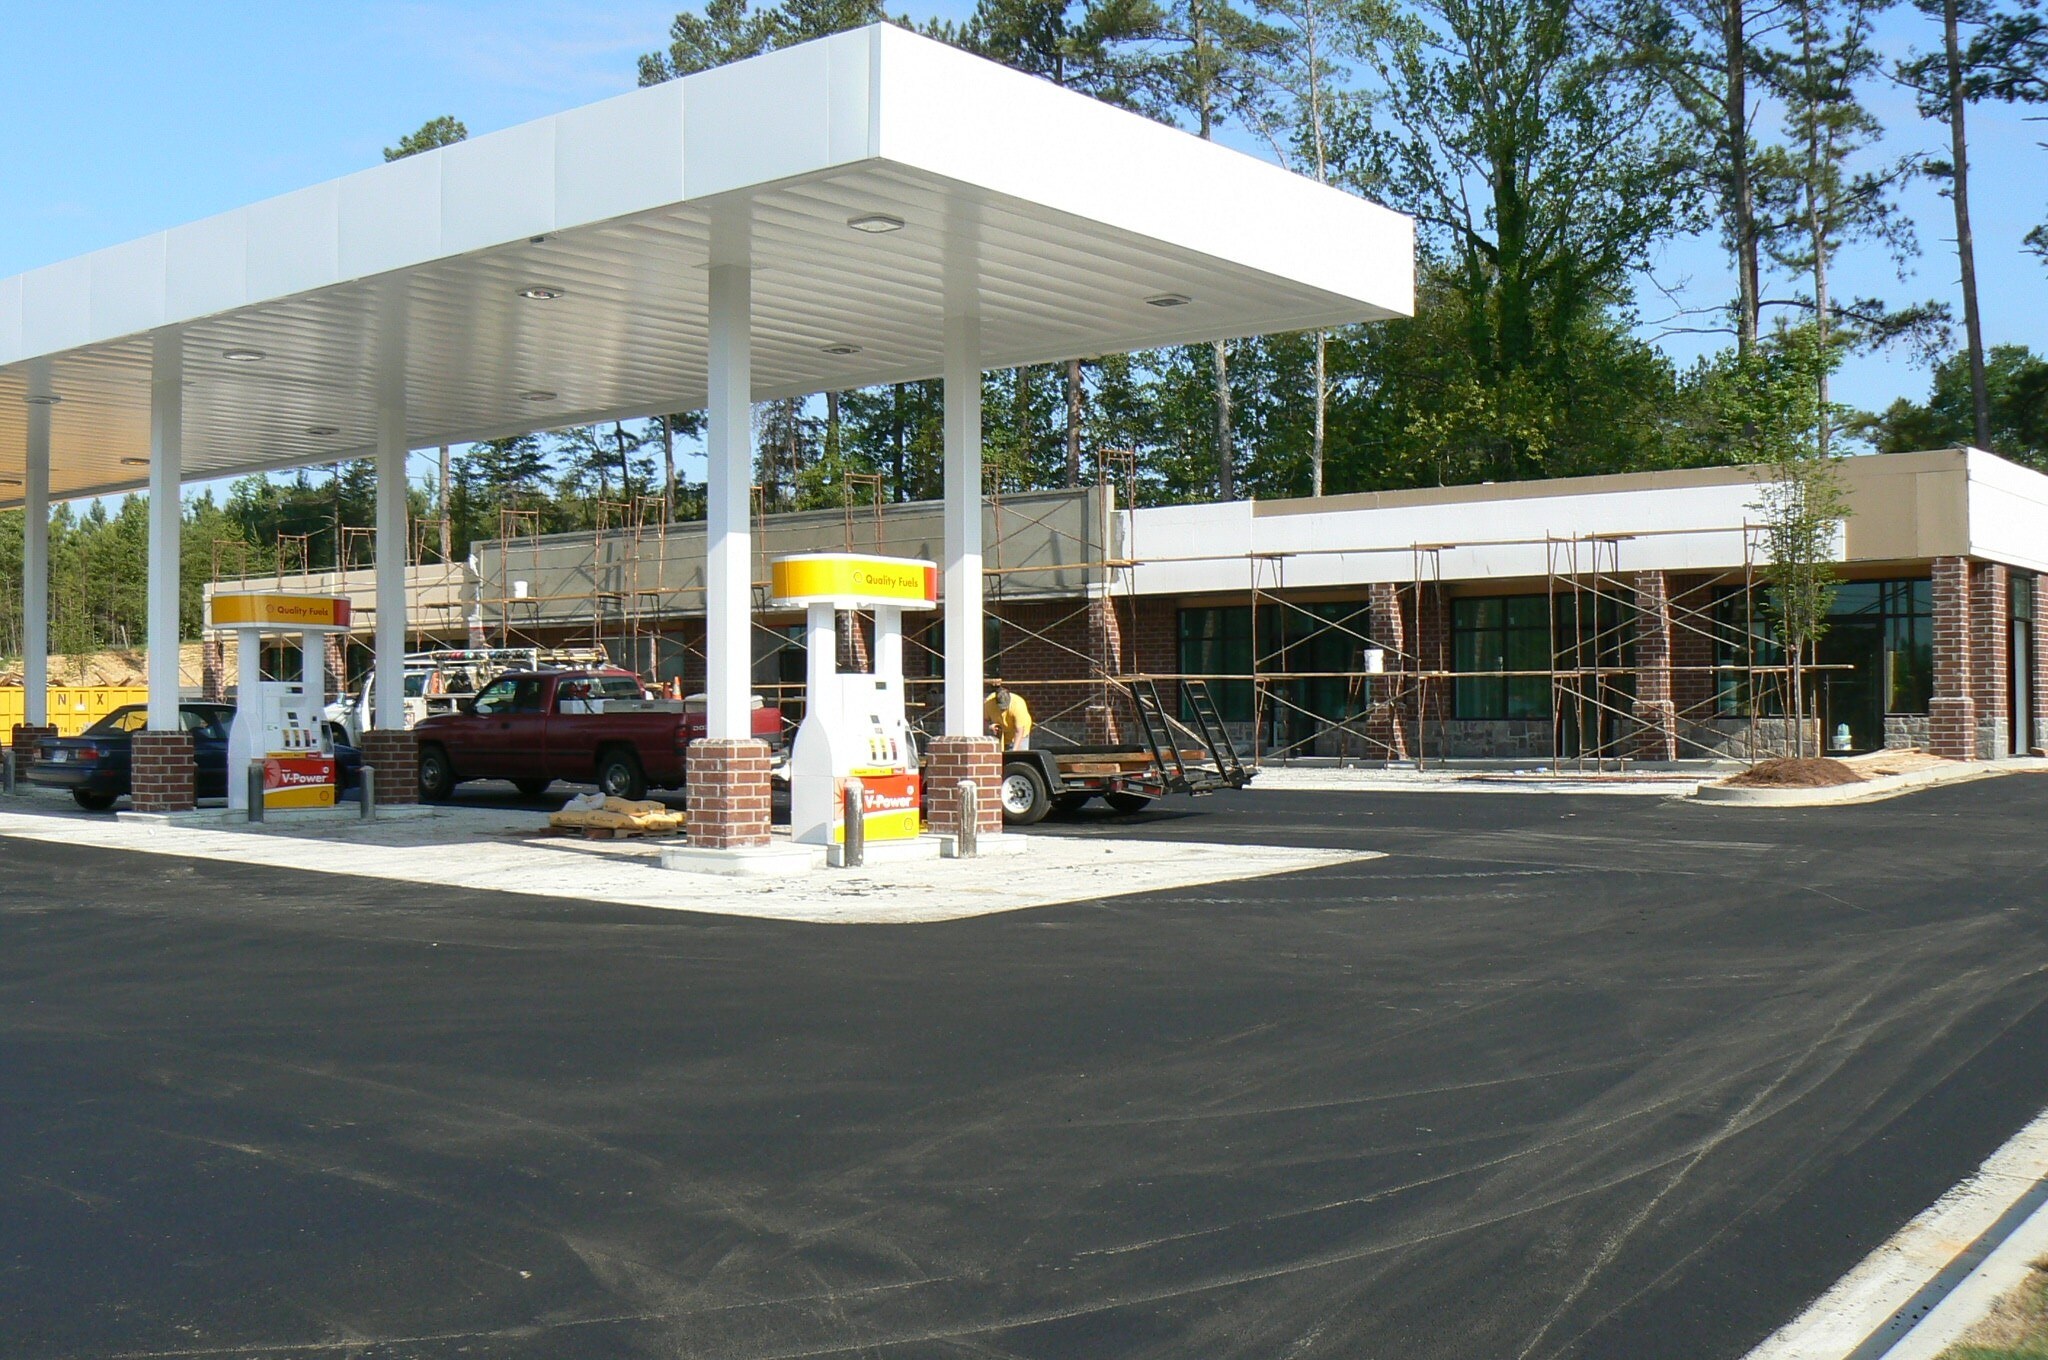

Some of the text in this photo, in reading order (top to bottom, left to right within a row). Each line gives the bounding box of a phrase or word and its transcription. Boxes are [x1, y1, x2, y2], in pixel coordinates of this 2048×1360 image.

[865, 574, 919, 588] Quality Fuels
[277, 606, 329, 617] Quality Fuels
[281, 773, 329, 784] V-Power
